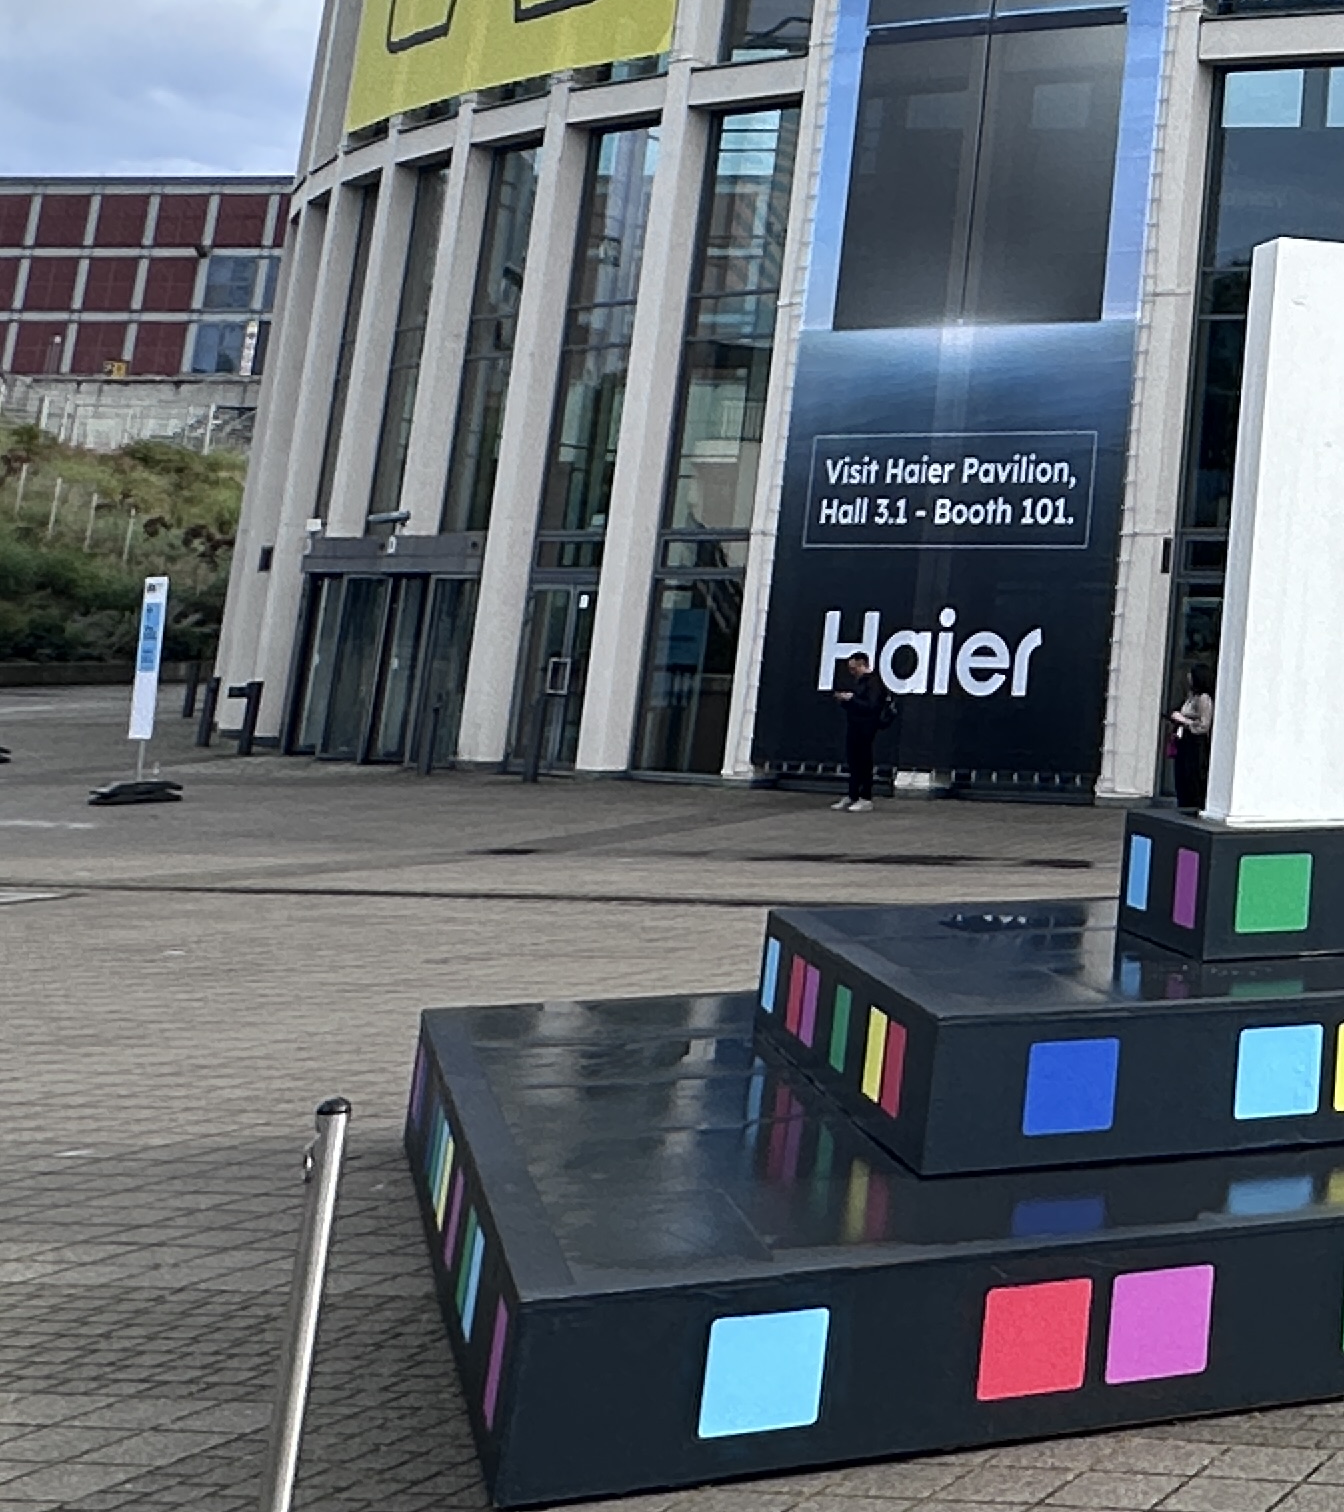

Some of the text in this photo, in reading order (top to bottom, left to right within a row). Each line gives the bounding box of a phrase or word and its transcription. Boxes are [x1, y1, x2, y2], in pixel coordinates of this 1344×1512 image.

[827, 453, 1077, 488] Visit Haier Pavilion,
[819, 498, 867, 524] Hall
[875, 499, 907, 524] 3.1
[934, 497, 1012, 524] Booth
[1021, 499, 1075, 524] 101.
[817, 607, 1043, 697] Haier
